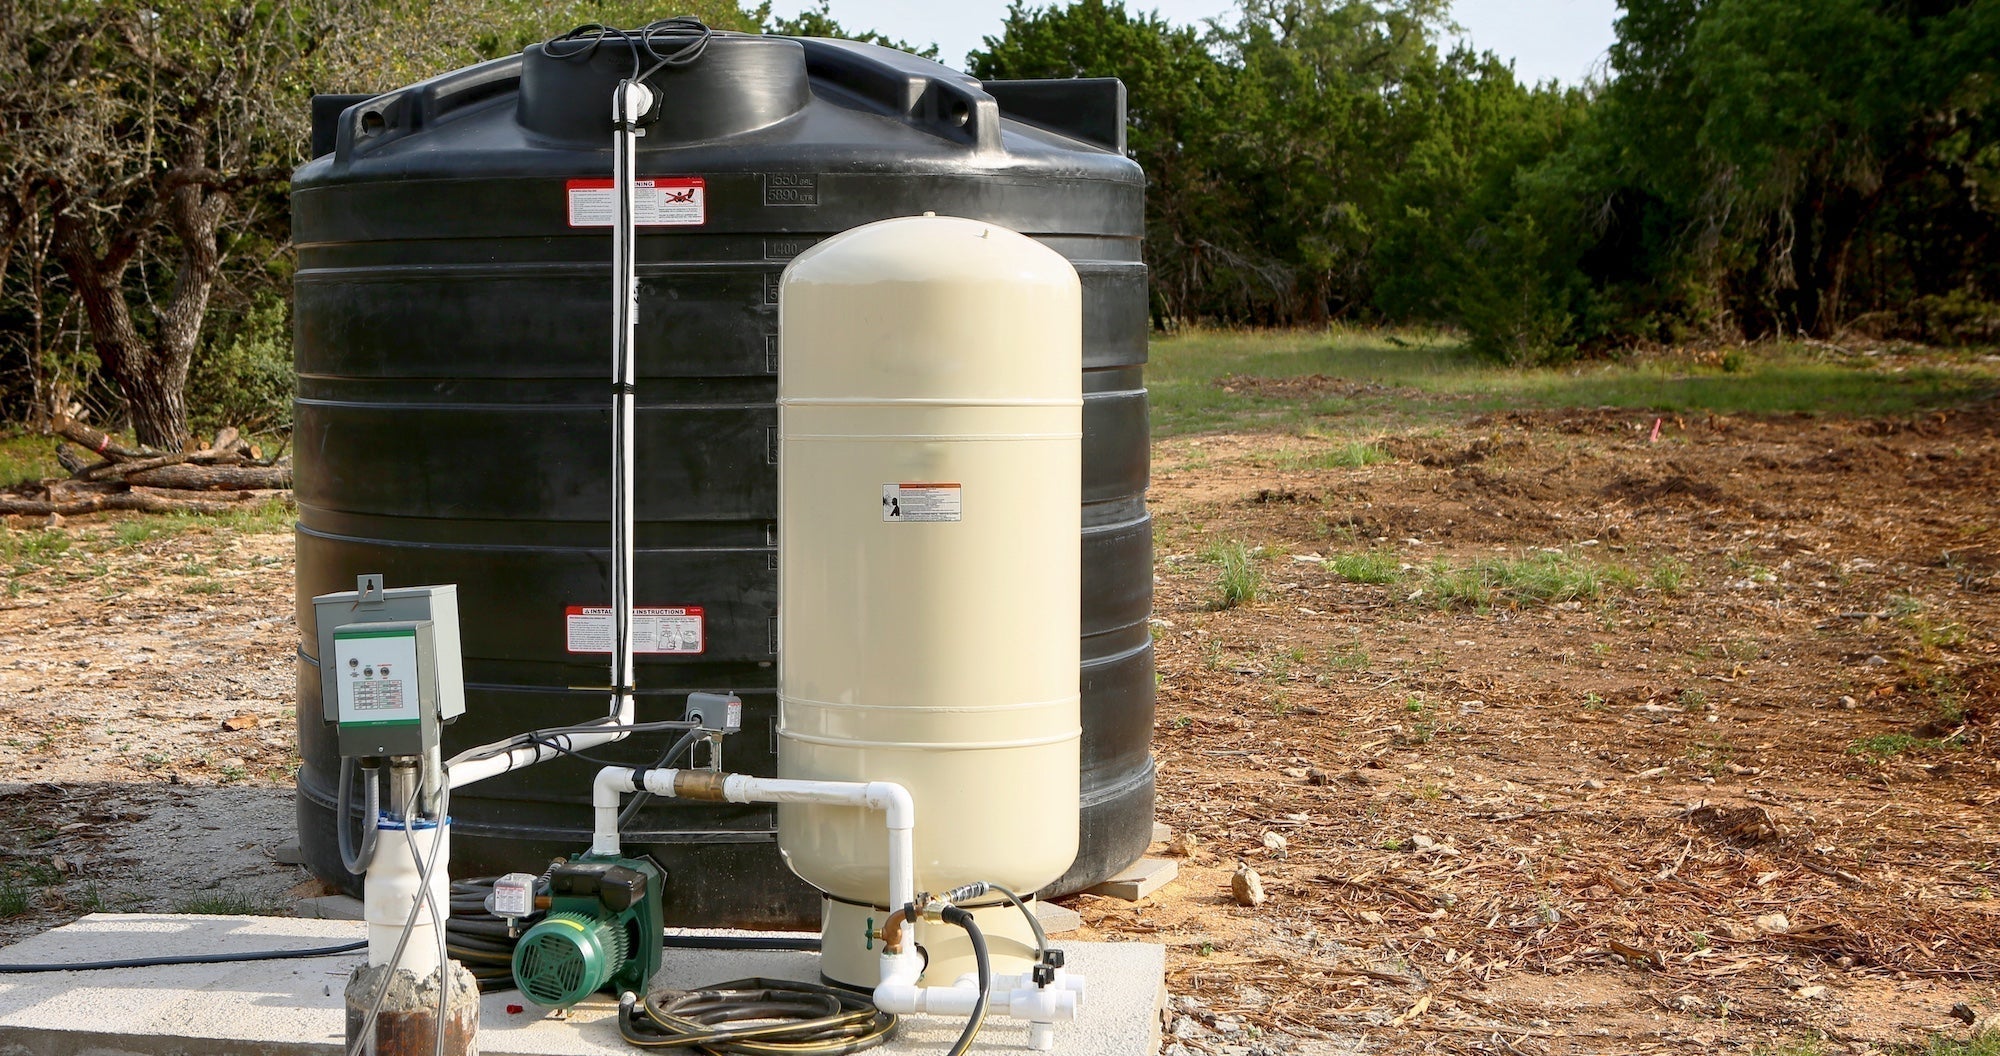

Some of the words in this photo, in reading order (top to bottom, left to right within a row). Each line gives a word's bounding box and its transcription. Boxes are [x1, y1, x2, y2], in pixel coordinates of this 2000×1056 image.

[771, 173, 798, 185] 1550
[768, 189, 798, 201] 5890
[772, 242, 798, 255] 1400
